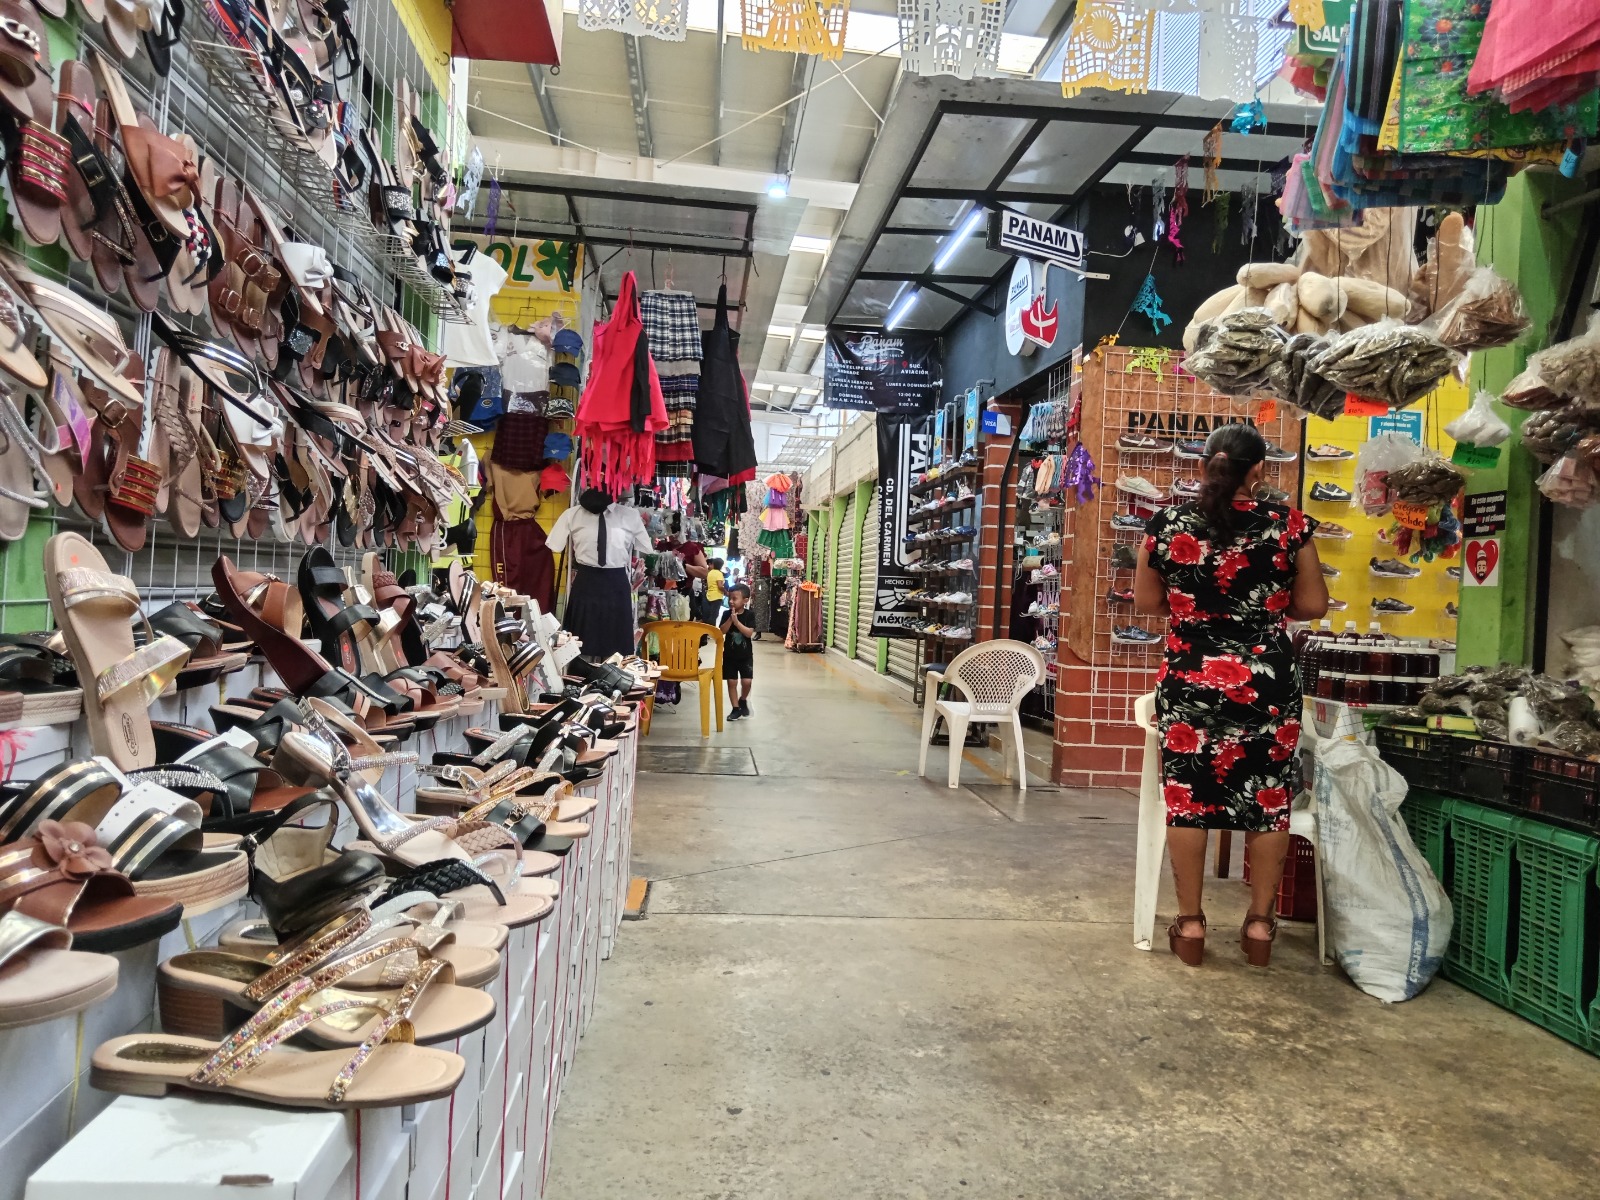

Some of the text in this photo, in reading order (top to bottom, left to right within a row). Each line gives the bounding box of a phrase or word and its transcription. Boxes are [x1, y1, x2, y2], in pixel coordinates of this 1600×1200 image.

[1008, 216, 1067, 248] PANAM
[882, 477, 894, 566] CD. DEL CARMEN
